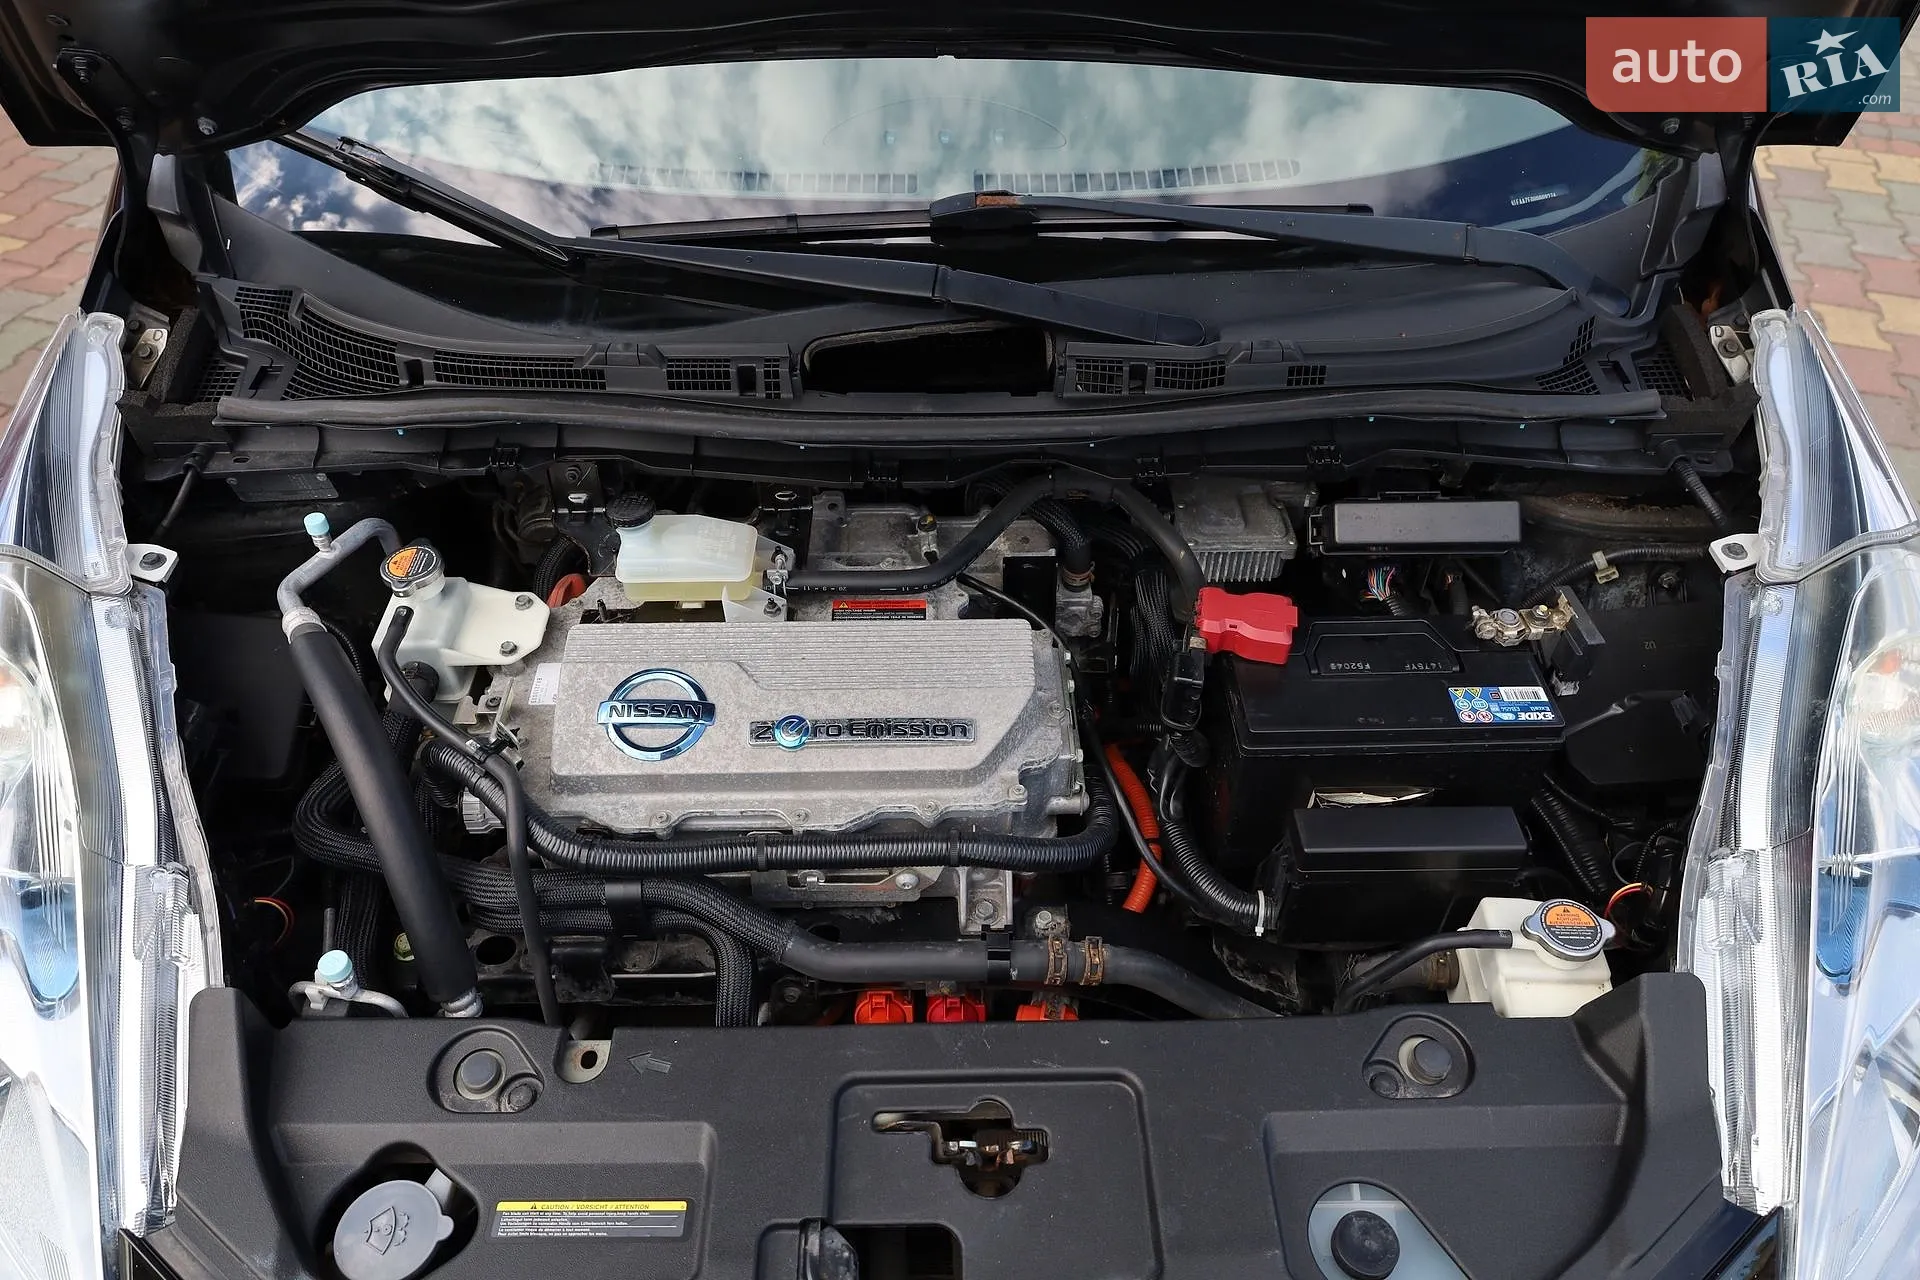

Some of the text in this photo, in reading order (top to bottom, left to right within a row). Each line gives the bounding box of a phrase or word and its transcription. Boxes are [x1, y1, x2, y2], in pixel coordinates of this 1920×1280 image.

[609, 703, 703, 719] NISSAN
[1518, 712, 1553, 720] EXIDE
[849, 722, 968, 739] Emission
